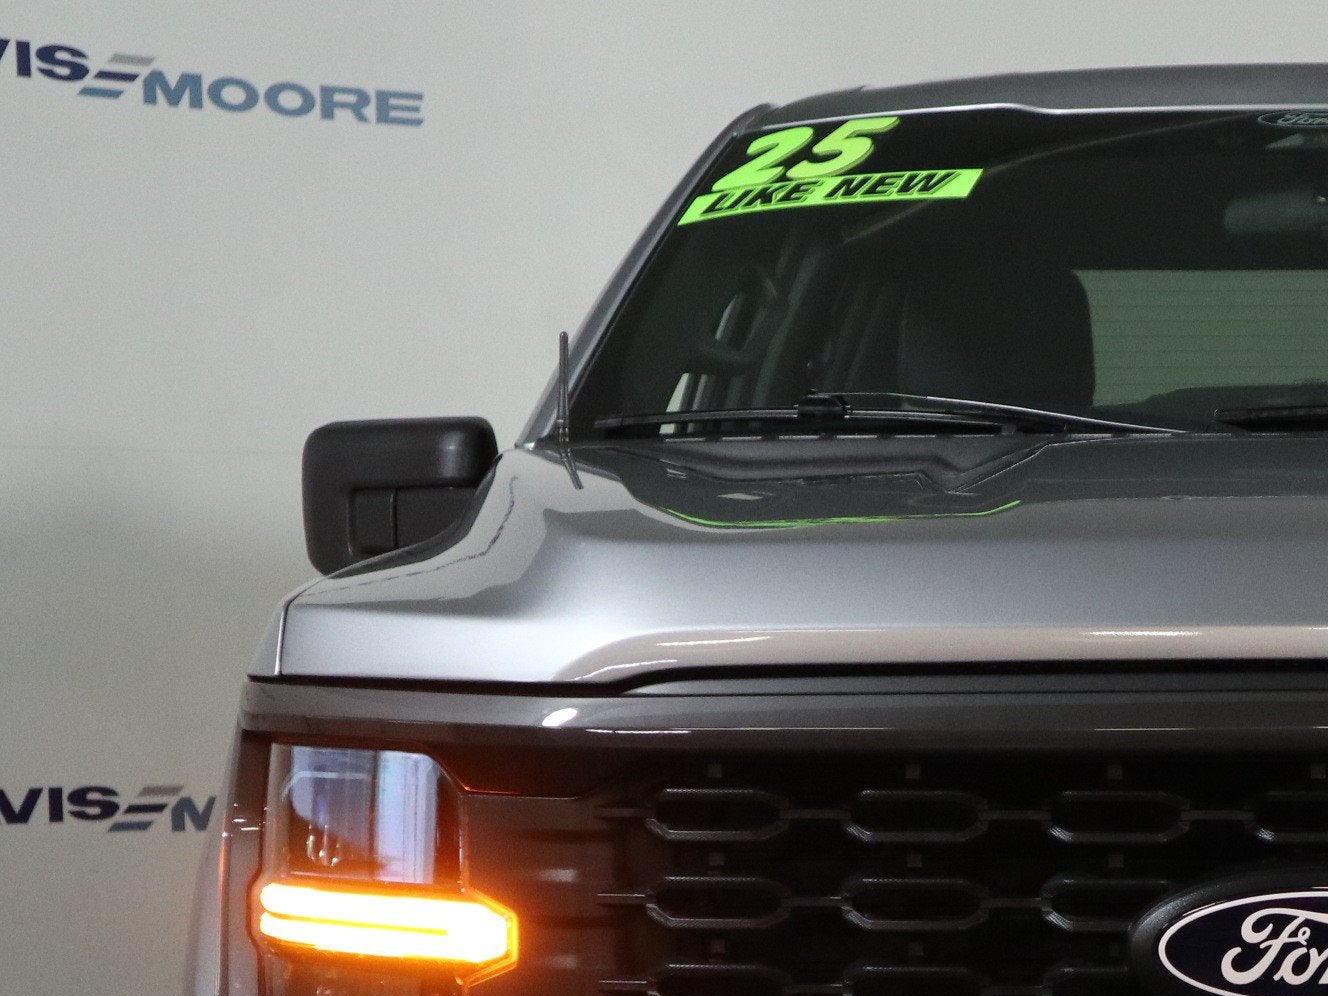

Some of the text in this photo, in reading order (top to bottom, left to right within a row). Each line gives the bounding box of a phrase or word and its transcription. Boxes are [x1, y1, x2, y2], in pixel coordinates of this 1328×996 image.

[0, 38, 425, 127] IS MOORE
[711, 116, 899, 192] 25
[701, 170, 963, 215] LIKE NEW
